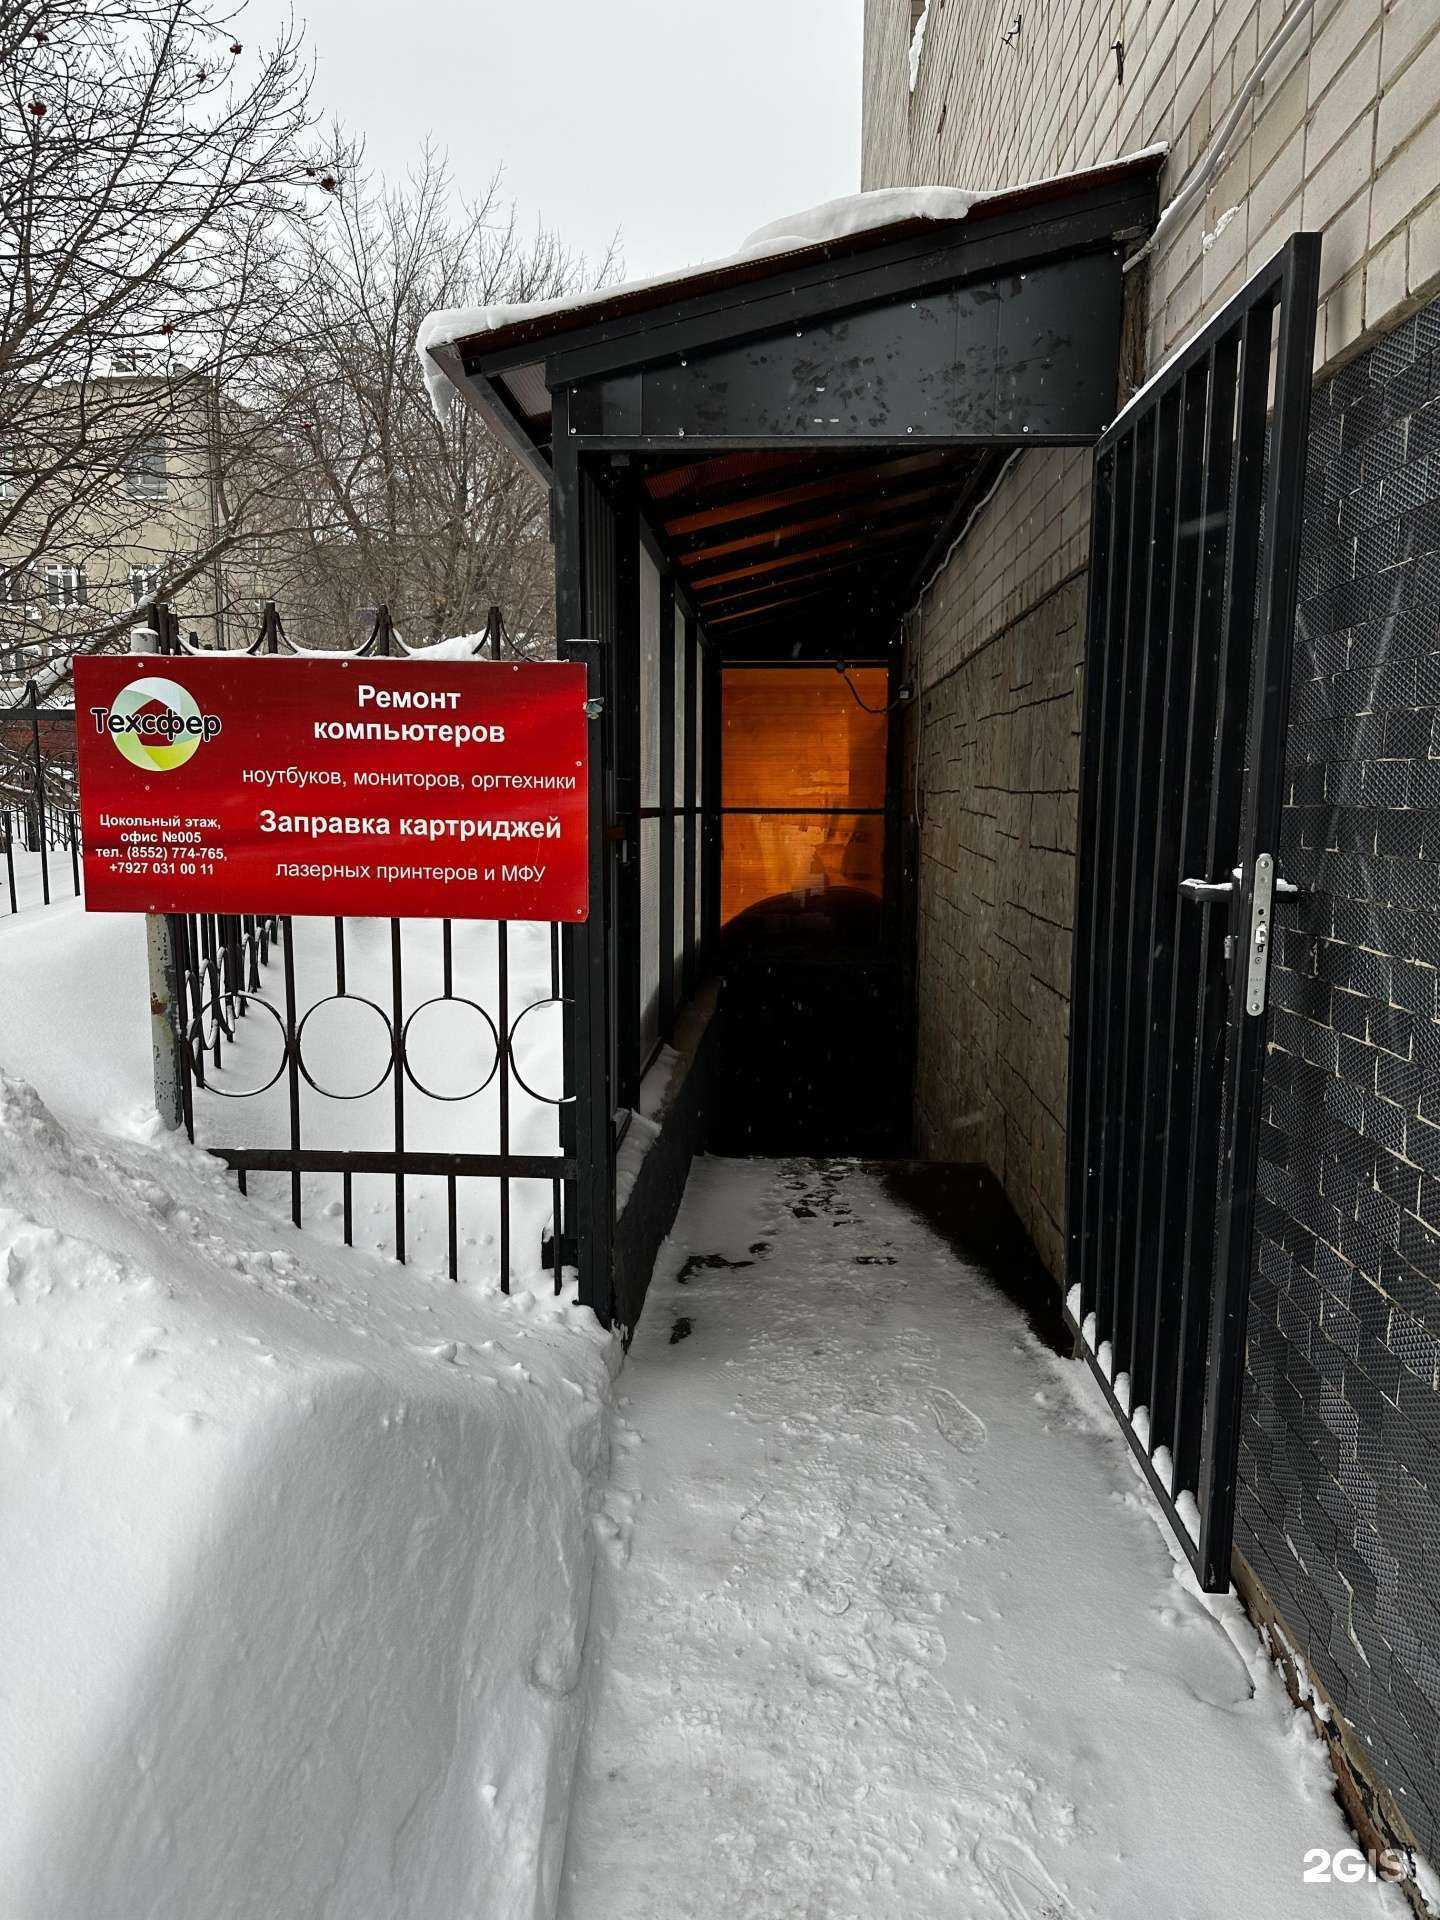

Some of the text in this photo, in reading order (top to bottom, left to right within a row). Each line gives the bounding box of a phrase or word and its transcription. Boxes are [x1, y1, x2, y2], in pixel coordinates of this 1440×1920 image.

[358, 685, 461, 709] Ремонт
[91, 708, 222, 742] Техсфер
[313, 722, 506, 747] компьютеров
[242, 767, 577, 792] ноутбуков, мониторов, оргтехники
[100, 814, 221, 829] Цокольный этаж,
[260, 809, 561, 840] Заправка картриджей
[120, 831, 202, 845] офис №005
[96, 847, 228, 861] тел. (8552) 774-765,
[109, 862, 214, 875] +7927 031 00 11
[275, 862, 546, 883] лазерных принтеров и МФУ
